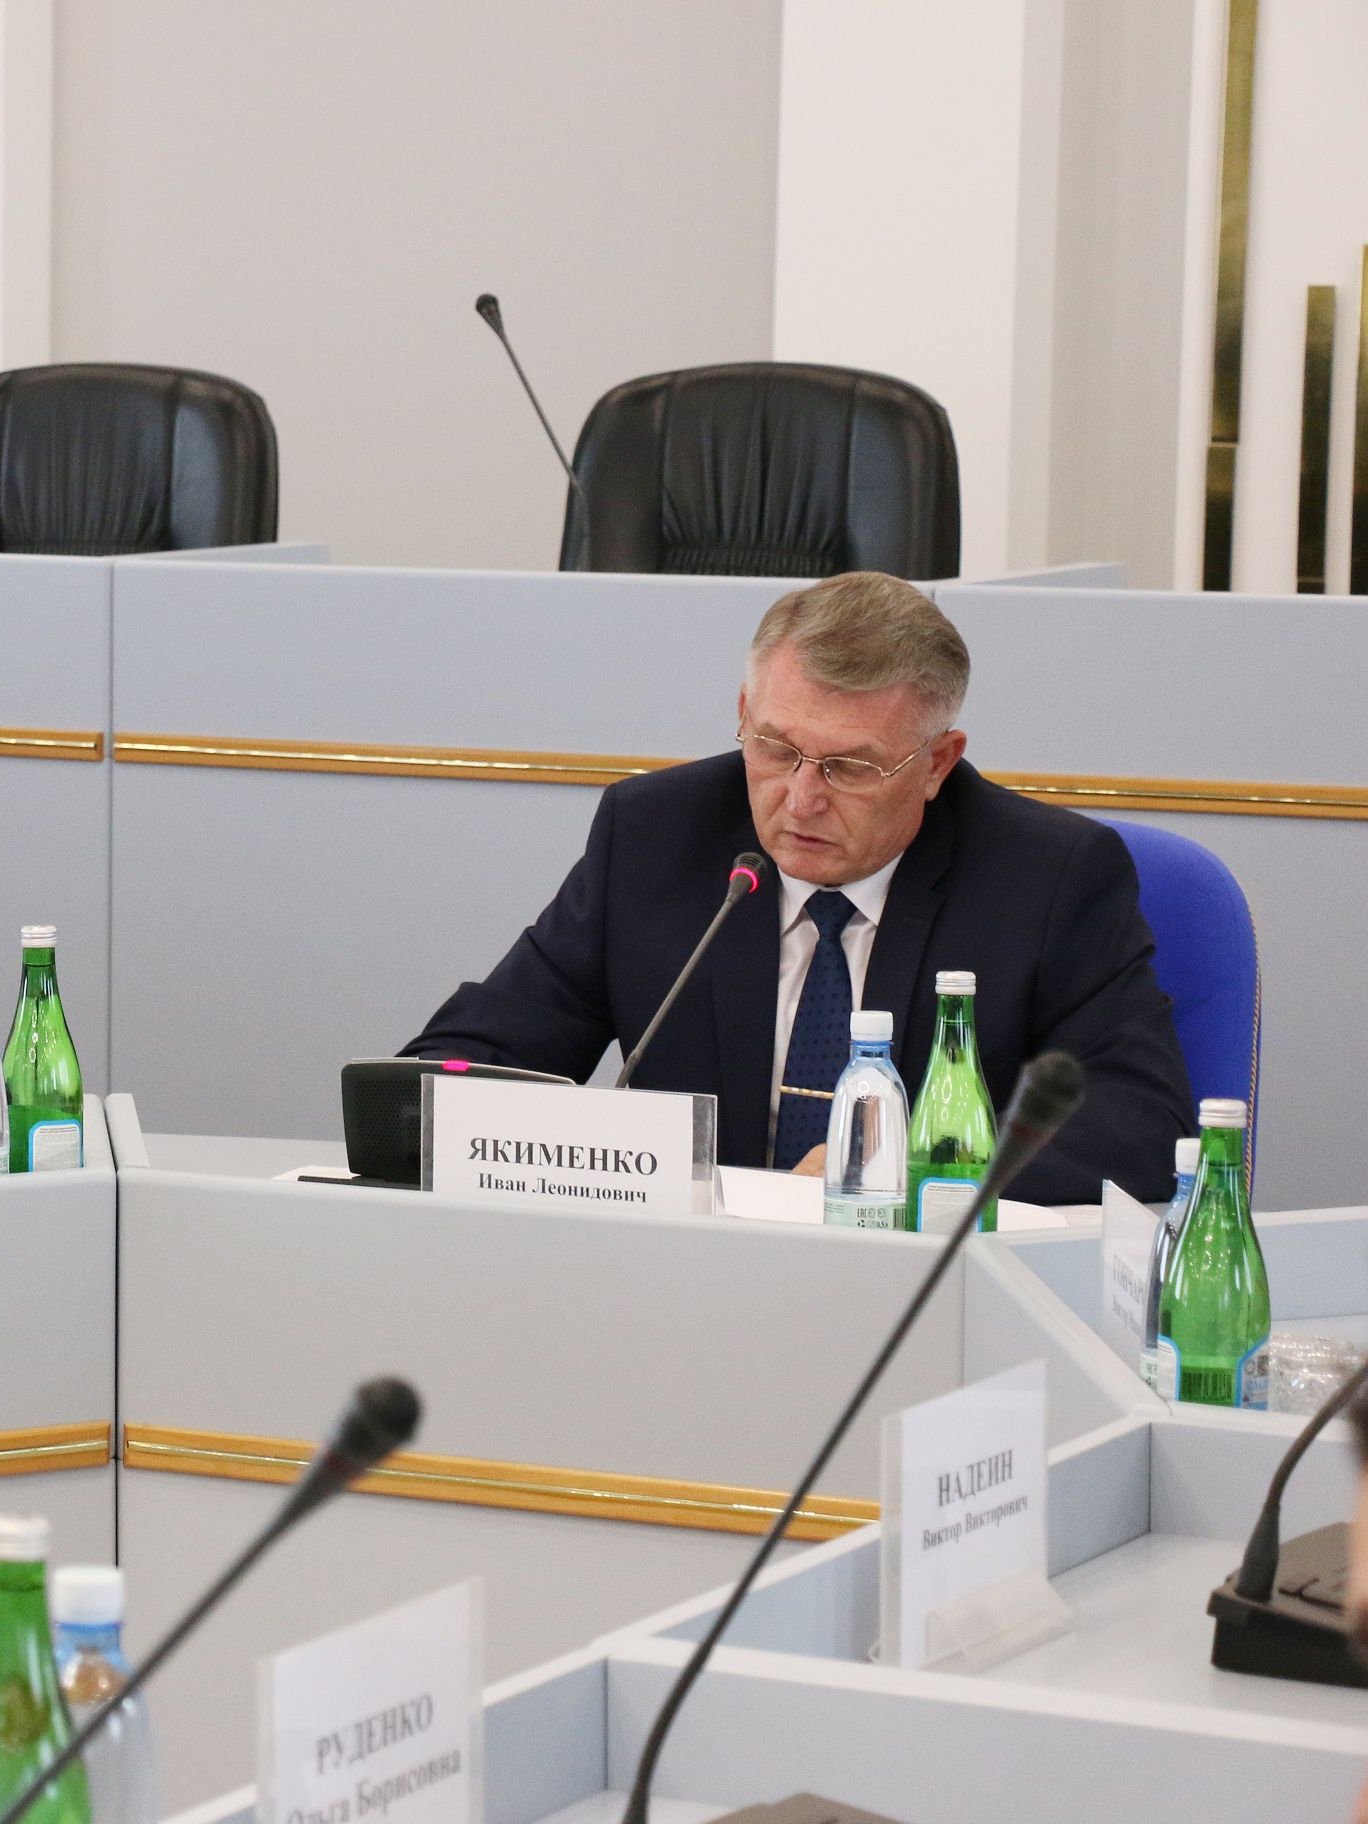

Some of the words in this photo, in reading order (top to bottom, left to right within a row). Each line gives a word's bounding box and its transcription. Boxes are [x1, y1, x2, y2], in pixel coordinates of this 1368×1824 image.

[468, 1137, 658, 1176] ЯКИМЕНКО
[478, 1172, 527, 1193] Иван
[532, 1177, 647, 1203] Леонидович
[937, 1447, 1014, 1508] НАДЕИН
[922, 1522, 963, 1552] Виктор
[965, 1494, 1029, 1534] Викторович
[315, 1692, 435, 1776] РУДЕНКО
[355, 1748, 463, 1818] Борисовна
